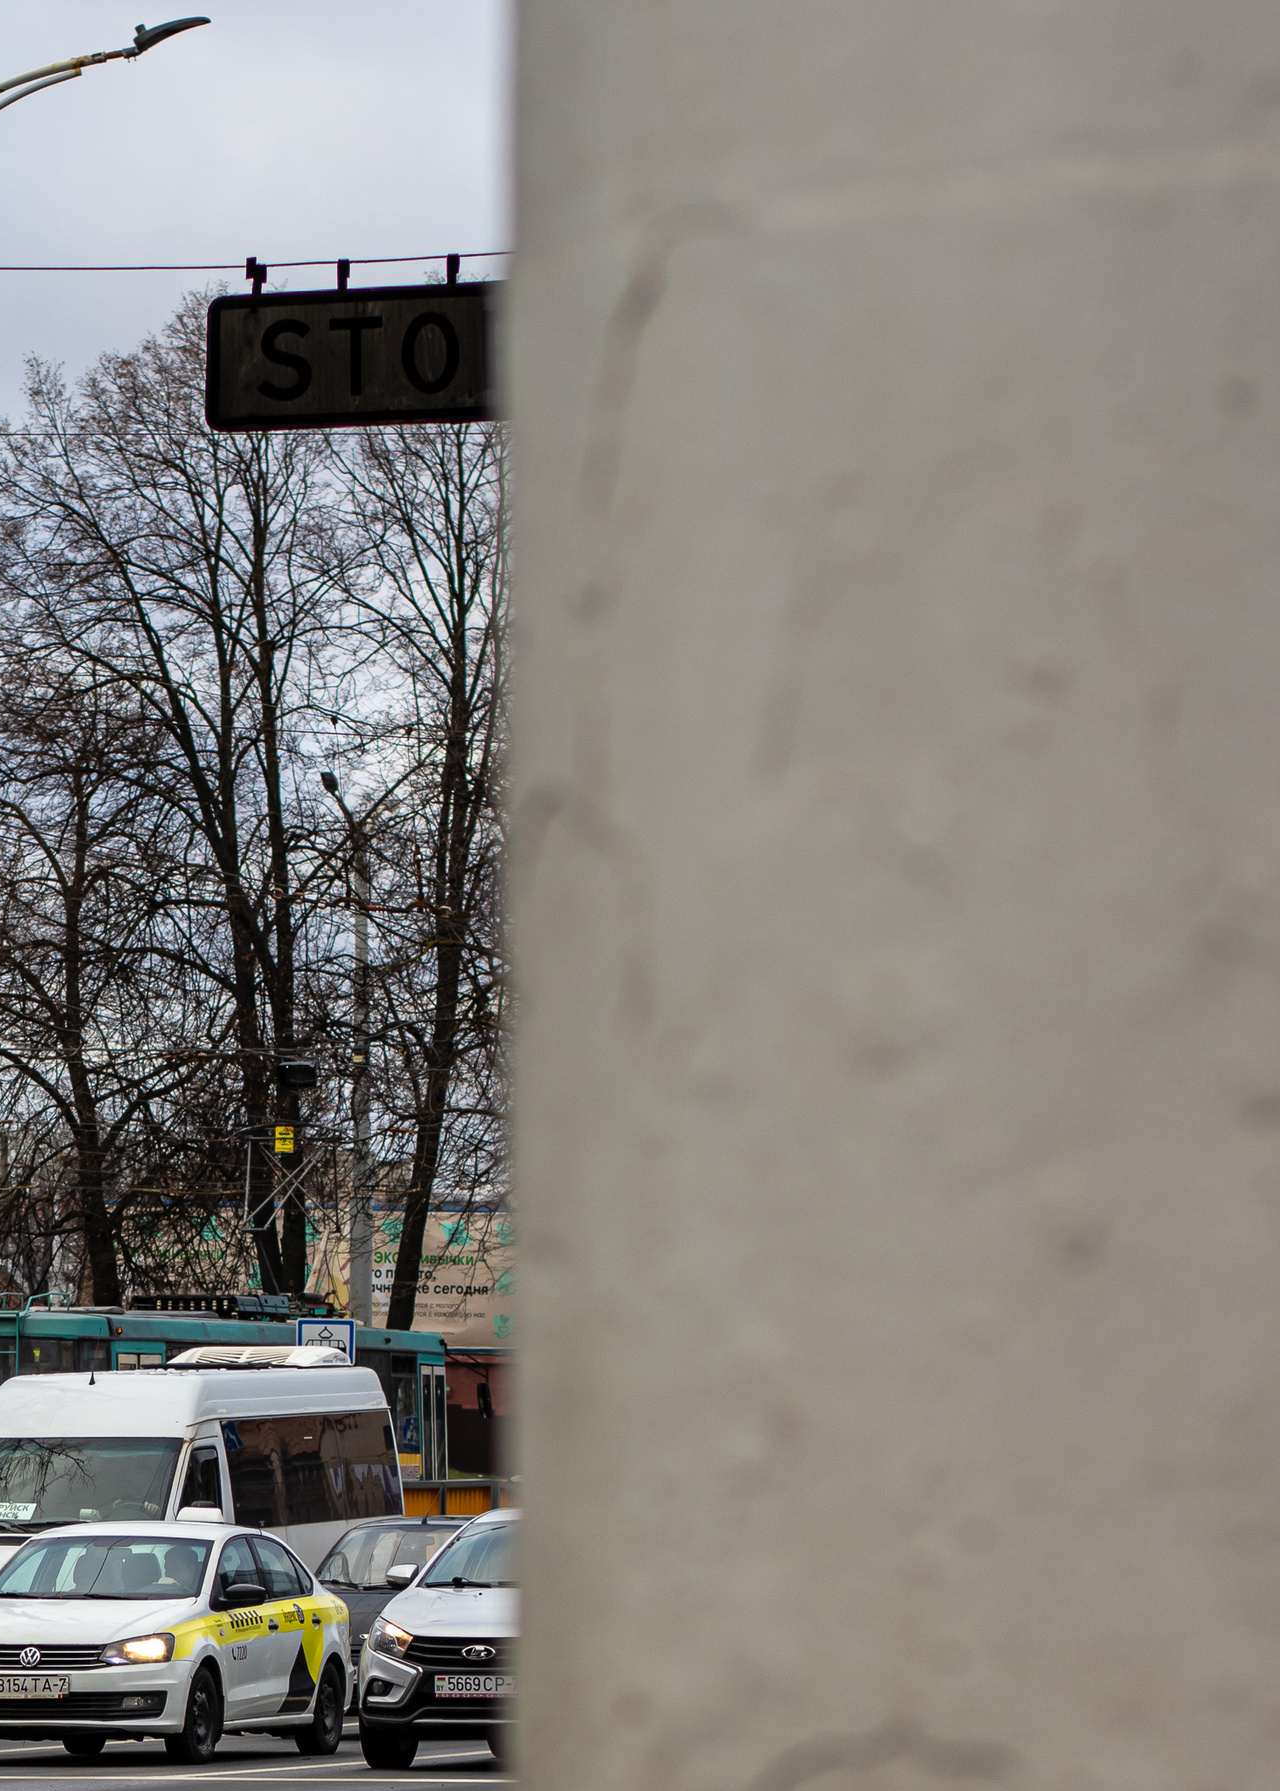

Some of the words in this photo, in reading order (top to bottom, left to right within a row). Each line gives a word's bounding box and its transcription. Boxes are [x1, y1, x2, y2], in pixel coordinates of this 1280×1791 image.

[257, 311, 486, 401] STO
[373, 1251, 474, 1266] ЭКОИВЫЧКИ
[433, 1285, 489, 1297] сегодня
[31, 1678, 67, 1693] TA-7
[447, 1676, 481, 1692] 5669
